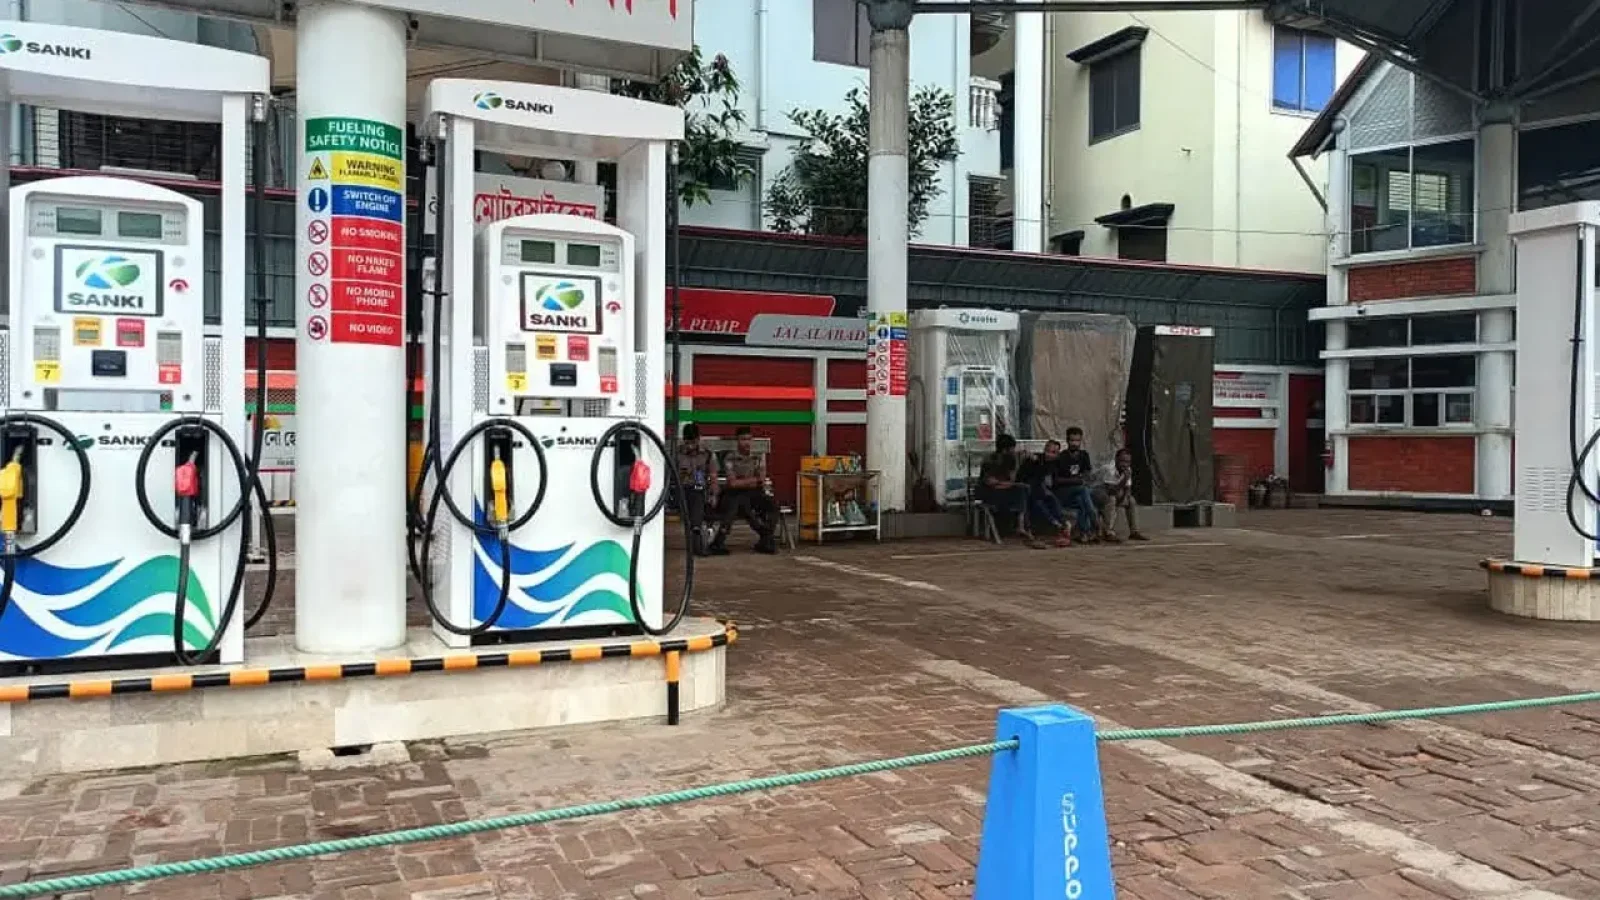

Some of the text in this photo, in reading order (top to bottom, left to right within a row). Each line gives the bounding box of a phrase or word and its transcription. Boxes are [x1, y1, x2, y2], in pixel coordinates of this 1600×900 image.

[26, 42, 91, 59] SANKI
[504, 99, 553, 114] SANKI
[328, 121, 385, 138] FUELING
[309, 134, 400, 155] SAFETY NOTICE
[345, 159, 396, 176] WARNING
[343, 190, 381, 201] SWITCH
[354, 201, 390, 213] ENGINE
[341, 227, 357, 236] NO
[347, 255, 363, 263] NO
[346, 287, 362, 296] NO
[67, 292, 144, 309] SANKI
[356, 297, 389, 307] PHONE
[529, 314, 588, 328] SANKI
[689, 319, 741, 333] PUMP
[349, 324, 395, 336] NO VIDEO
[43, 369, 51, 380] 7
[556, 436, 598, 446] SANKI
